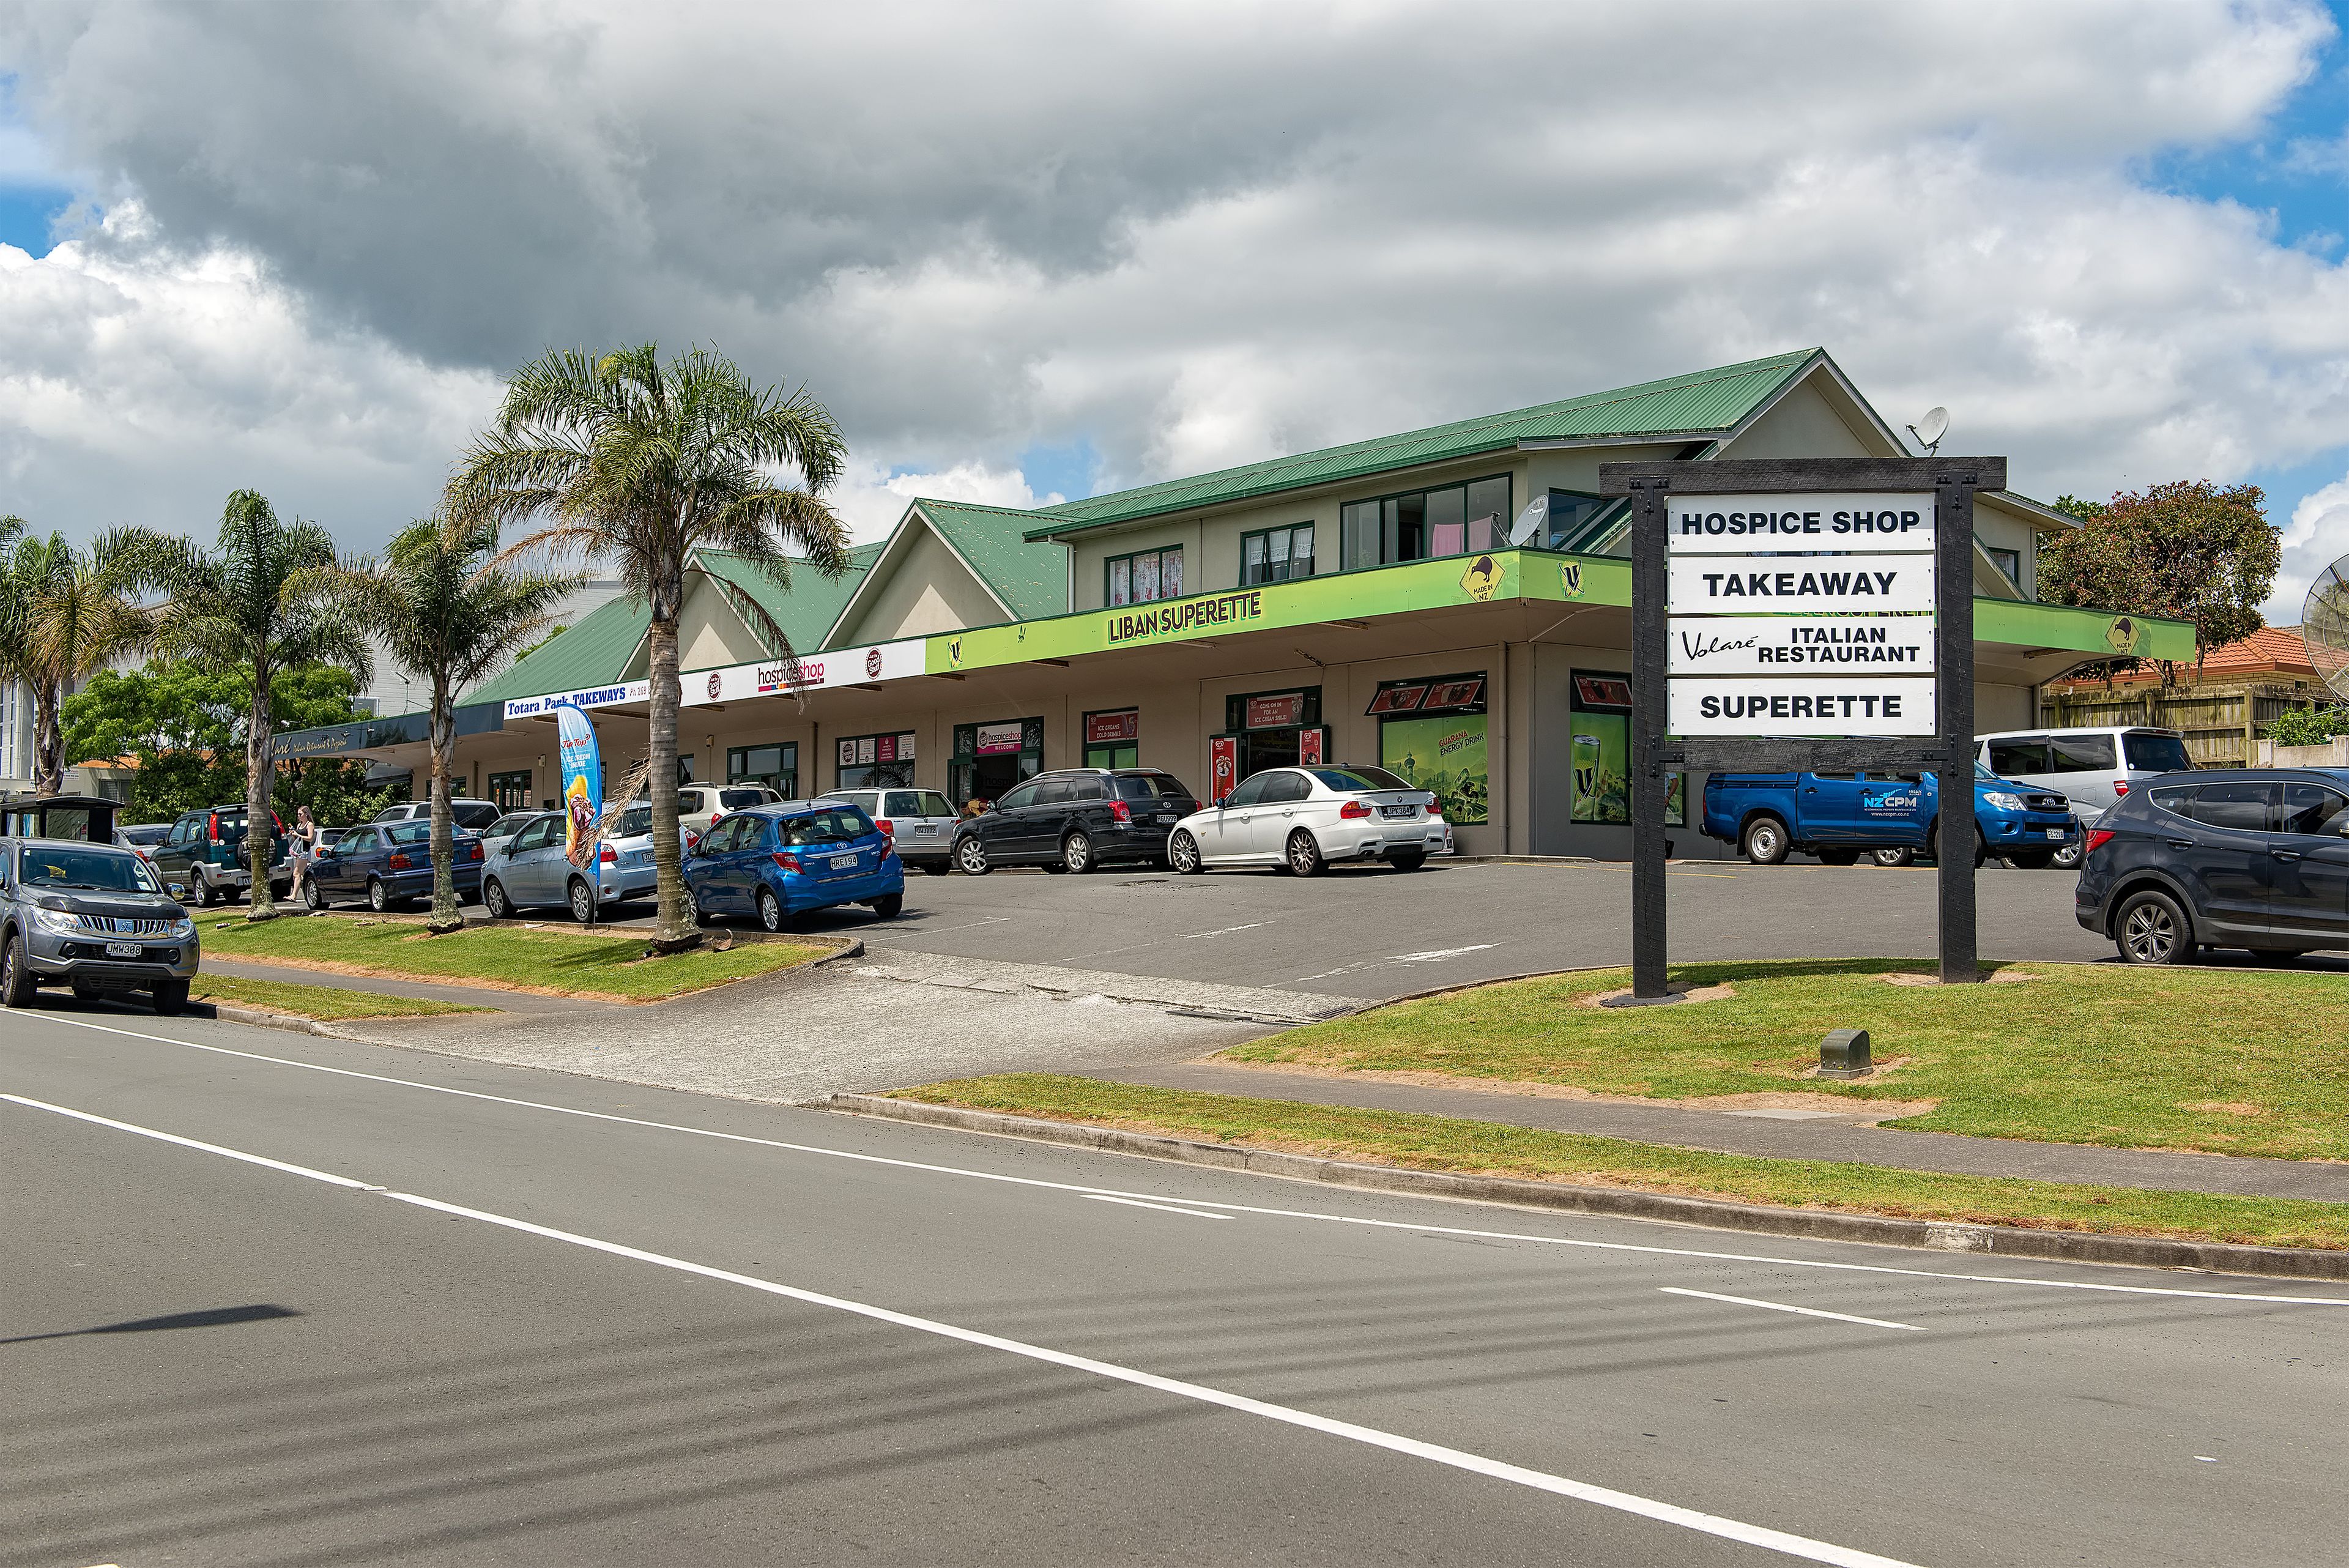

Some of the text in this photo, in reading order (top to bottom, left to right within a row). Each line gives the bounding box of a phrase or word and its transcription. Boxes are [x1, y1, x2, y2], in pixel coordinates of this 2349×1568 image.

[1682, 510, 1920, 535] HOSPICE SHOP
[1473, 585, 1487, 595] MADE
[1702, 572, 1898, 596] TAKEAWAY
[1479, 592, 1488, 602] NZ
[1110, 592, 1261, 642] LIBAN SUPERETTE
[1792, 627, 1886, 644] ITALIAN
[1682, 631, 1759, 661] Volaré
[1758, 646, 1920, 663] RESTAURANT
[508, 702, 540, 715] Totara
[544, 695, 568, 710] Park
[573, 687, 626, 706] TAKEWAYS
[1701, 696, 1902, 719] SUPERETTE
[562, 740, 573, 749] Tip
[1439, 730, 1468, 748] GUARANA
[1440, 732, 1485, 756] ENERGY DRINK
[1864, 797, 1917, 807] NZCPM
[644, 853, 655, 861] JDS
[831, 855, 857, 868] HRE194
[108, 944, 141, 954] JMW308
